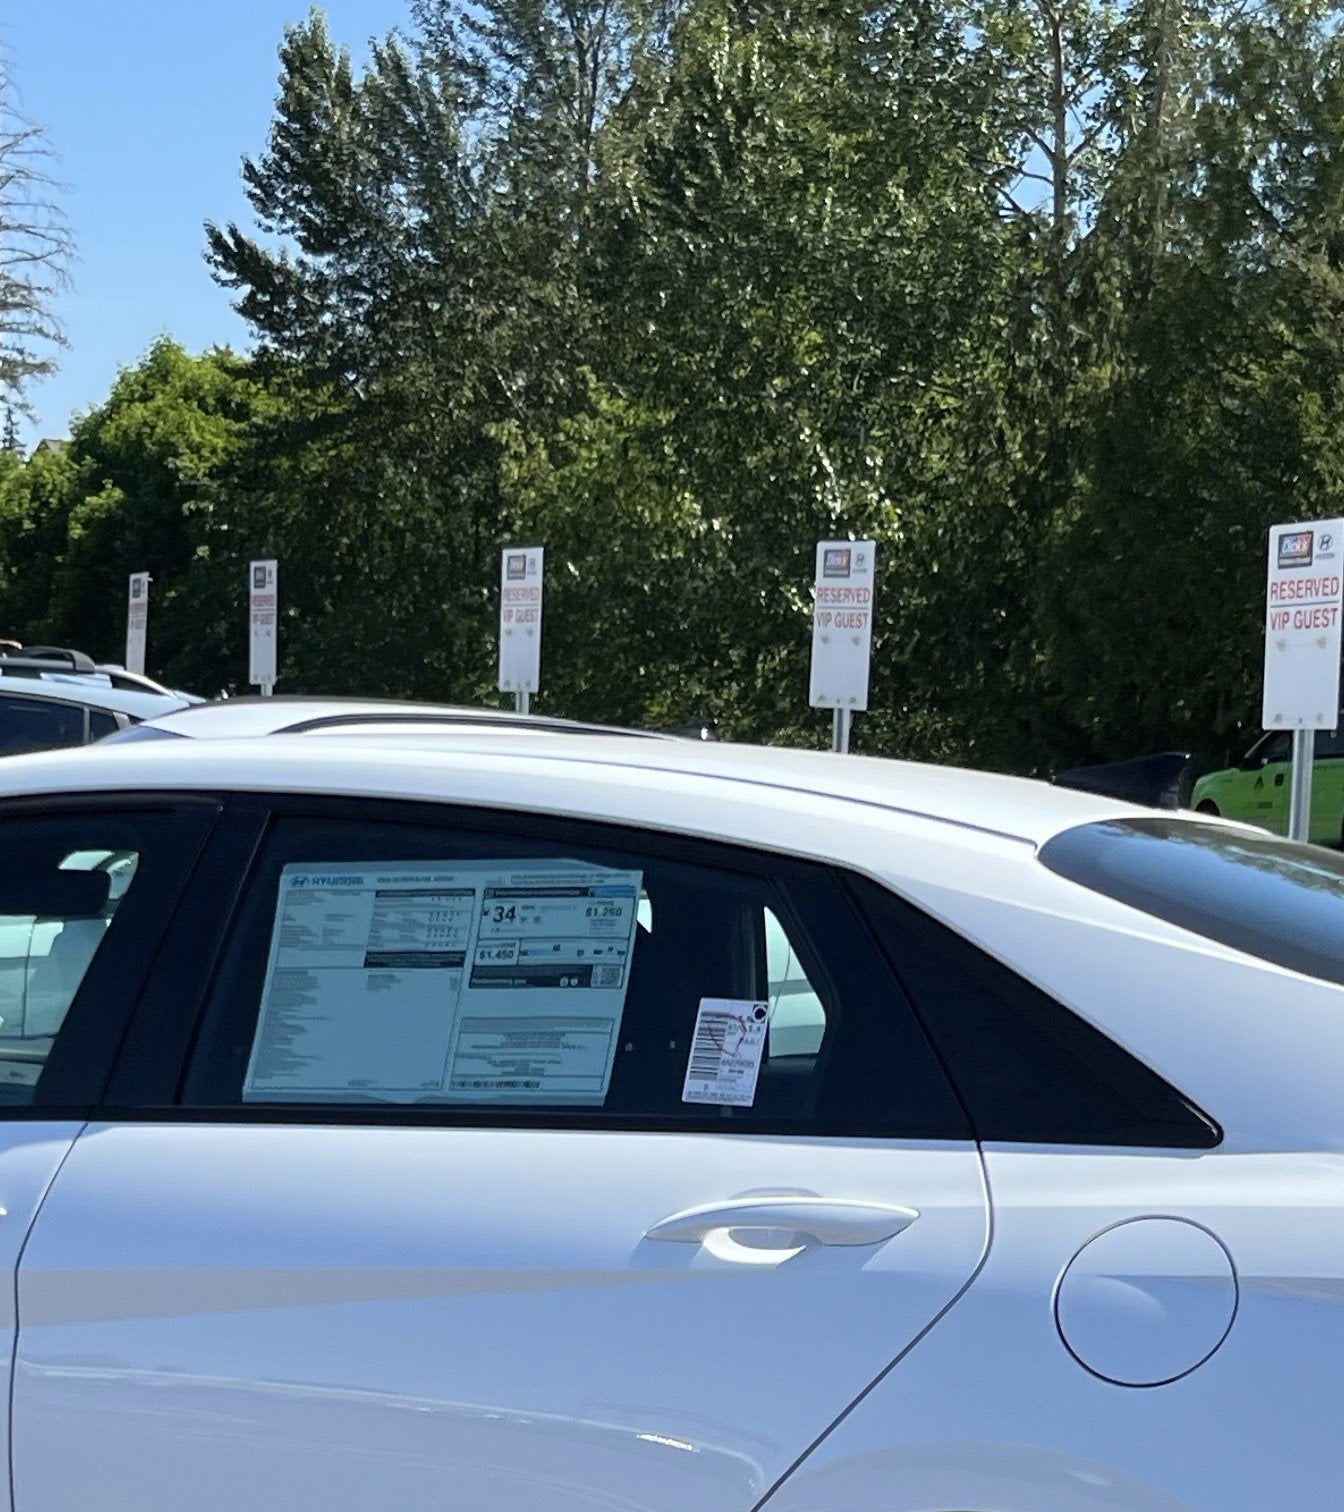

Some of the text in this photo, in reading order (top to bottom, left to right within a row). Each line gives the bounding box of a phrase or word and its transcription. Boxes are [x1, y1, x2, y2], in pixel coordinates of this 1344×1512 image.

[816, 587, 871, 603] RESERVED
[1270, 576, 1340, 600] RESERVED
[834, 611, 869, 629] GUEST
[1270, 607, 1338, 630] VIP GUEST
